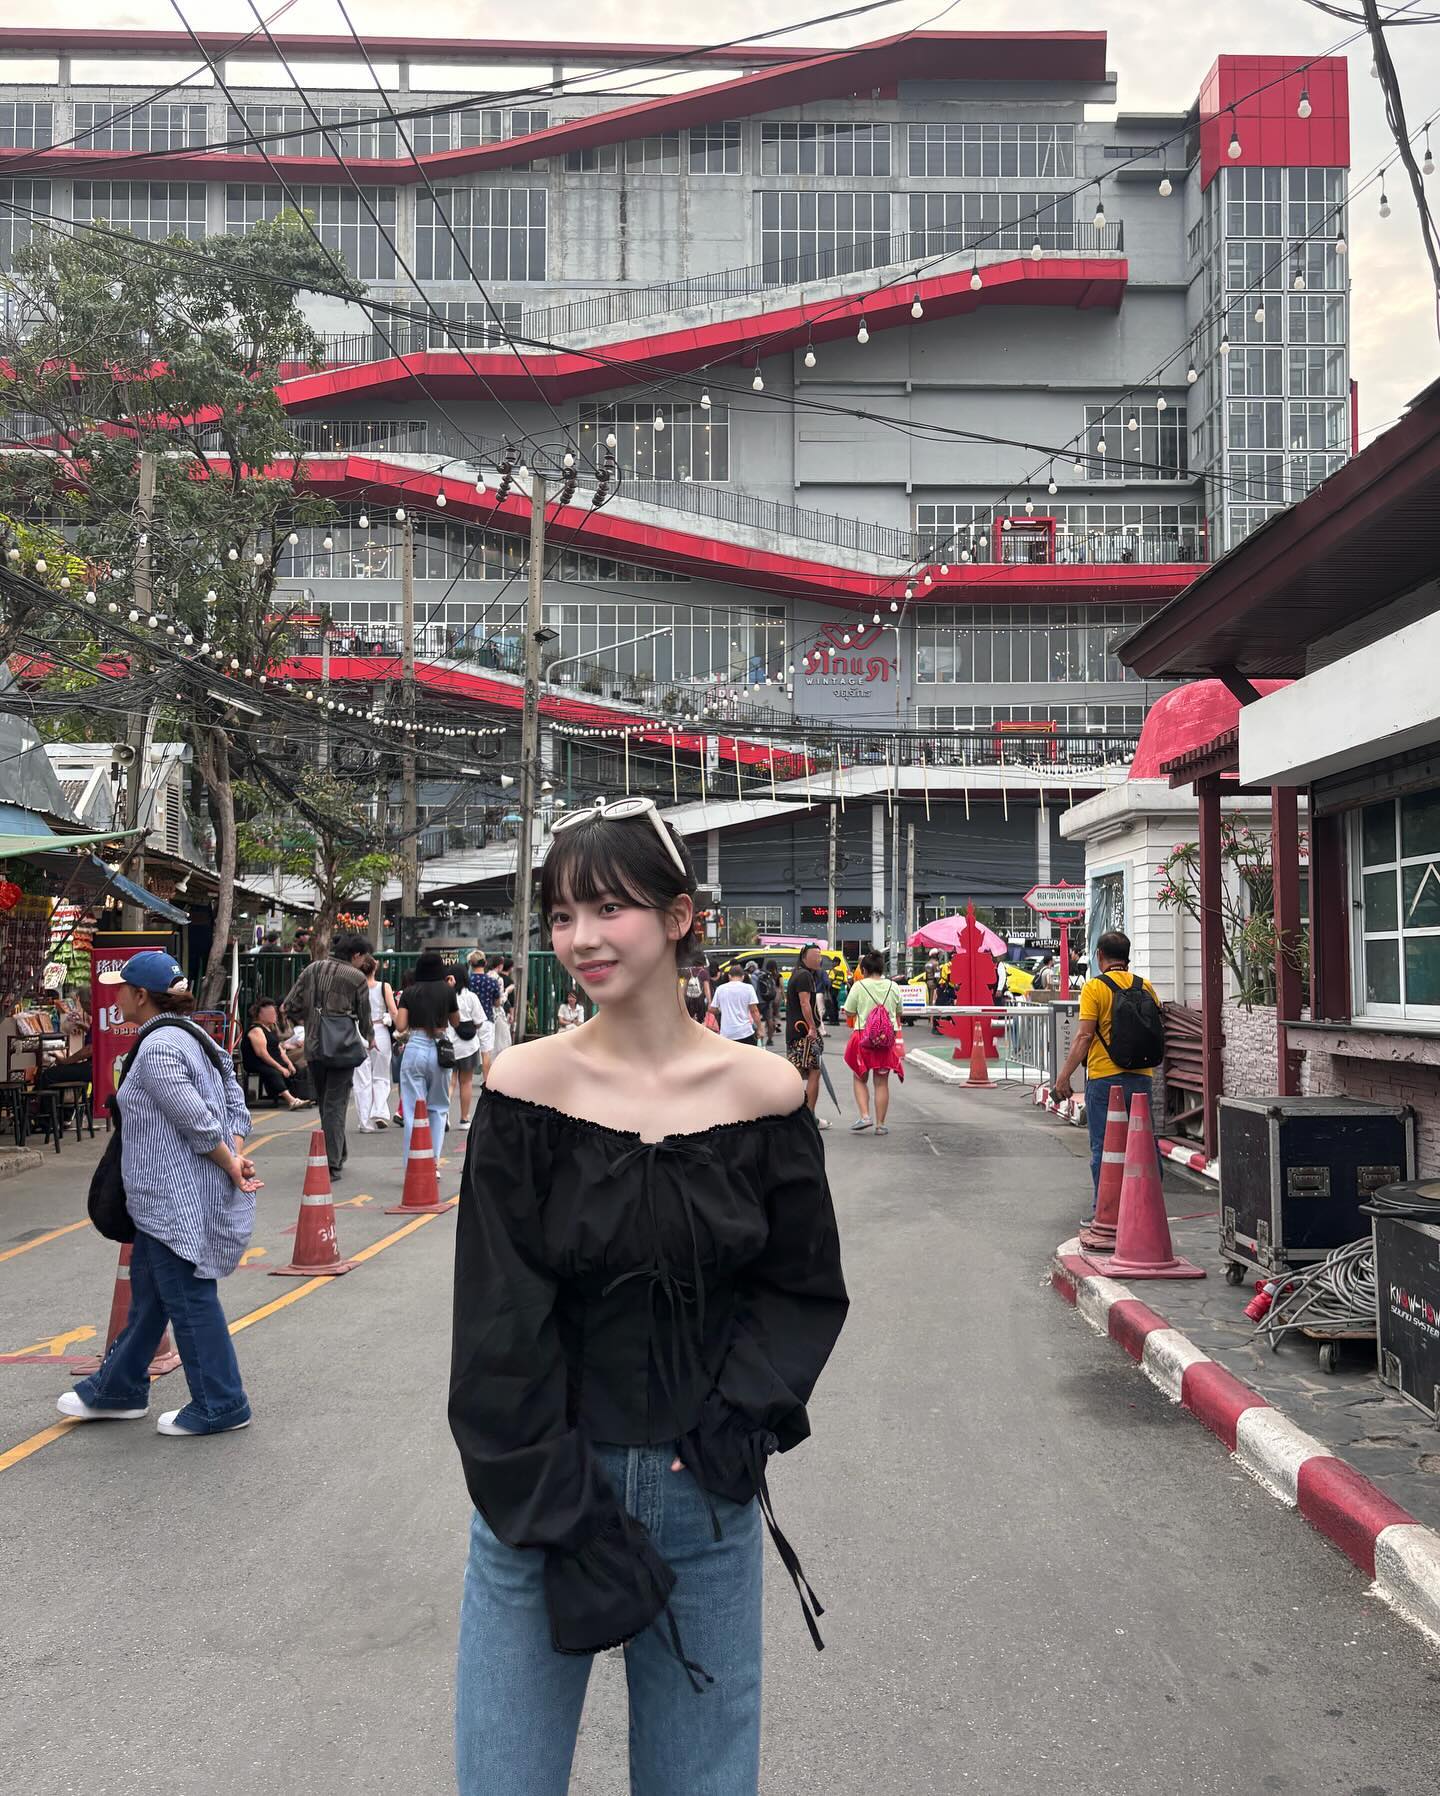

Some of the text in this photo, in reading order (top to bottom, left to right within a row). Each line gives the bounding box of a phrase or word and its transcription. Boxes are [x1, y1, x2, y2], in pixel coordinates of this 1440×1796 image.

[1036, 889, 1085, 901] ตลาดนัดจตุจัก
